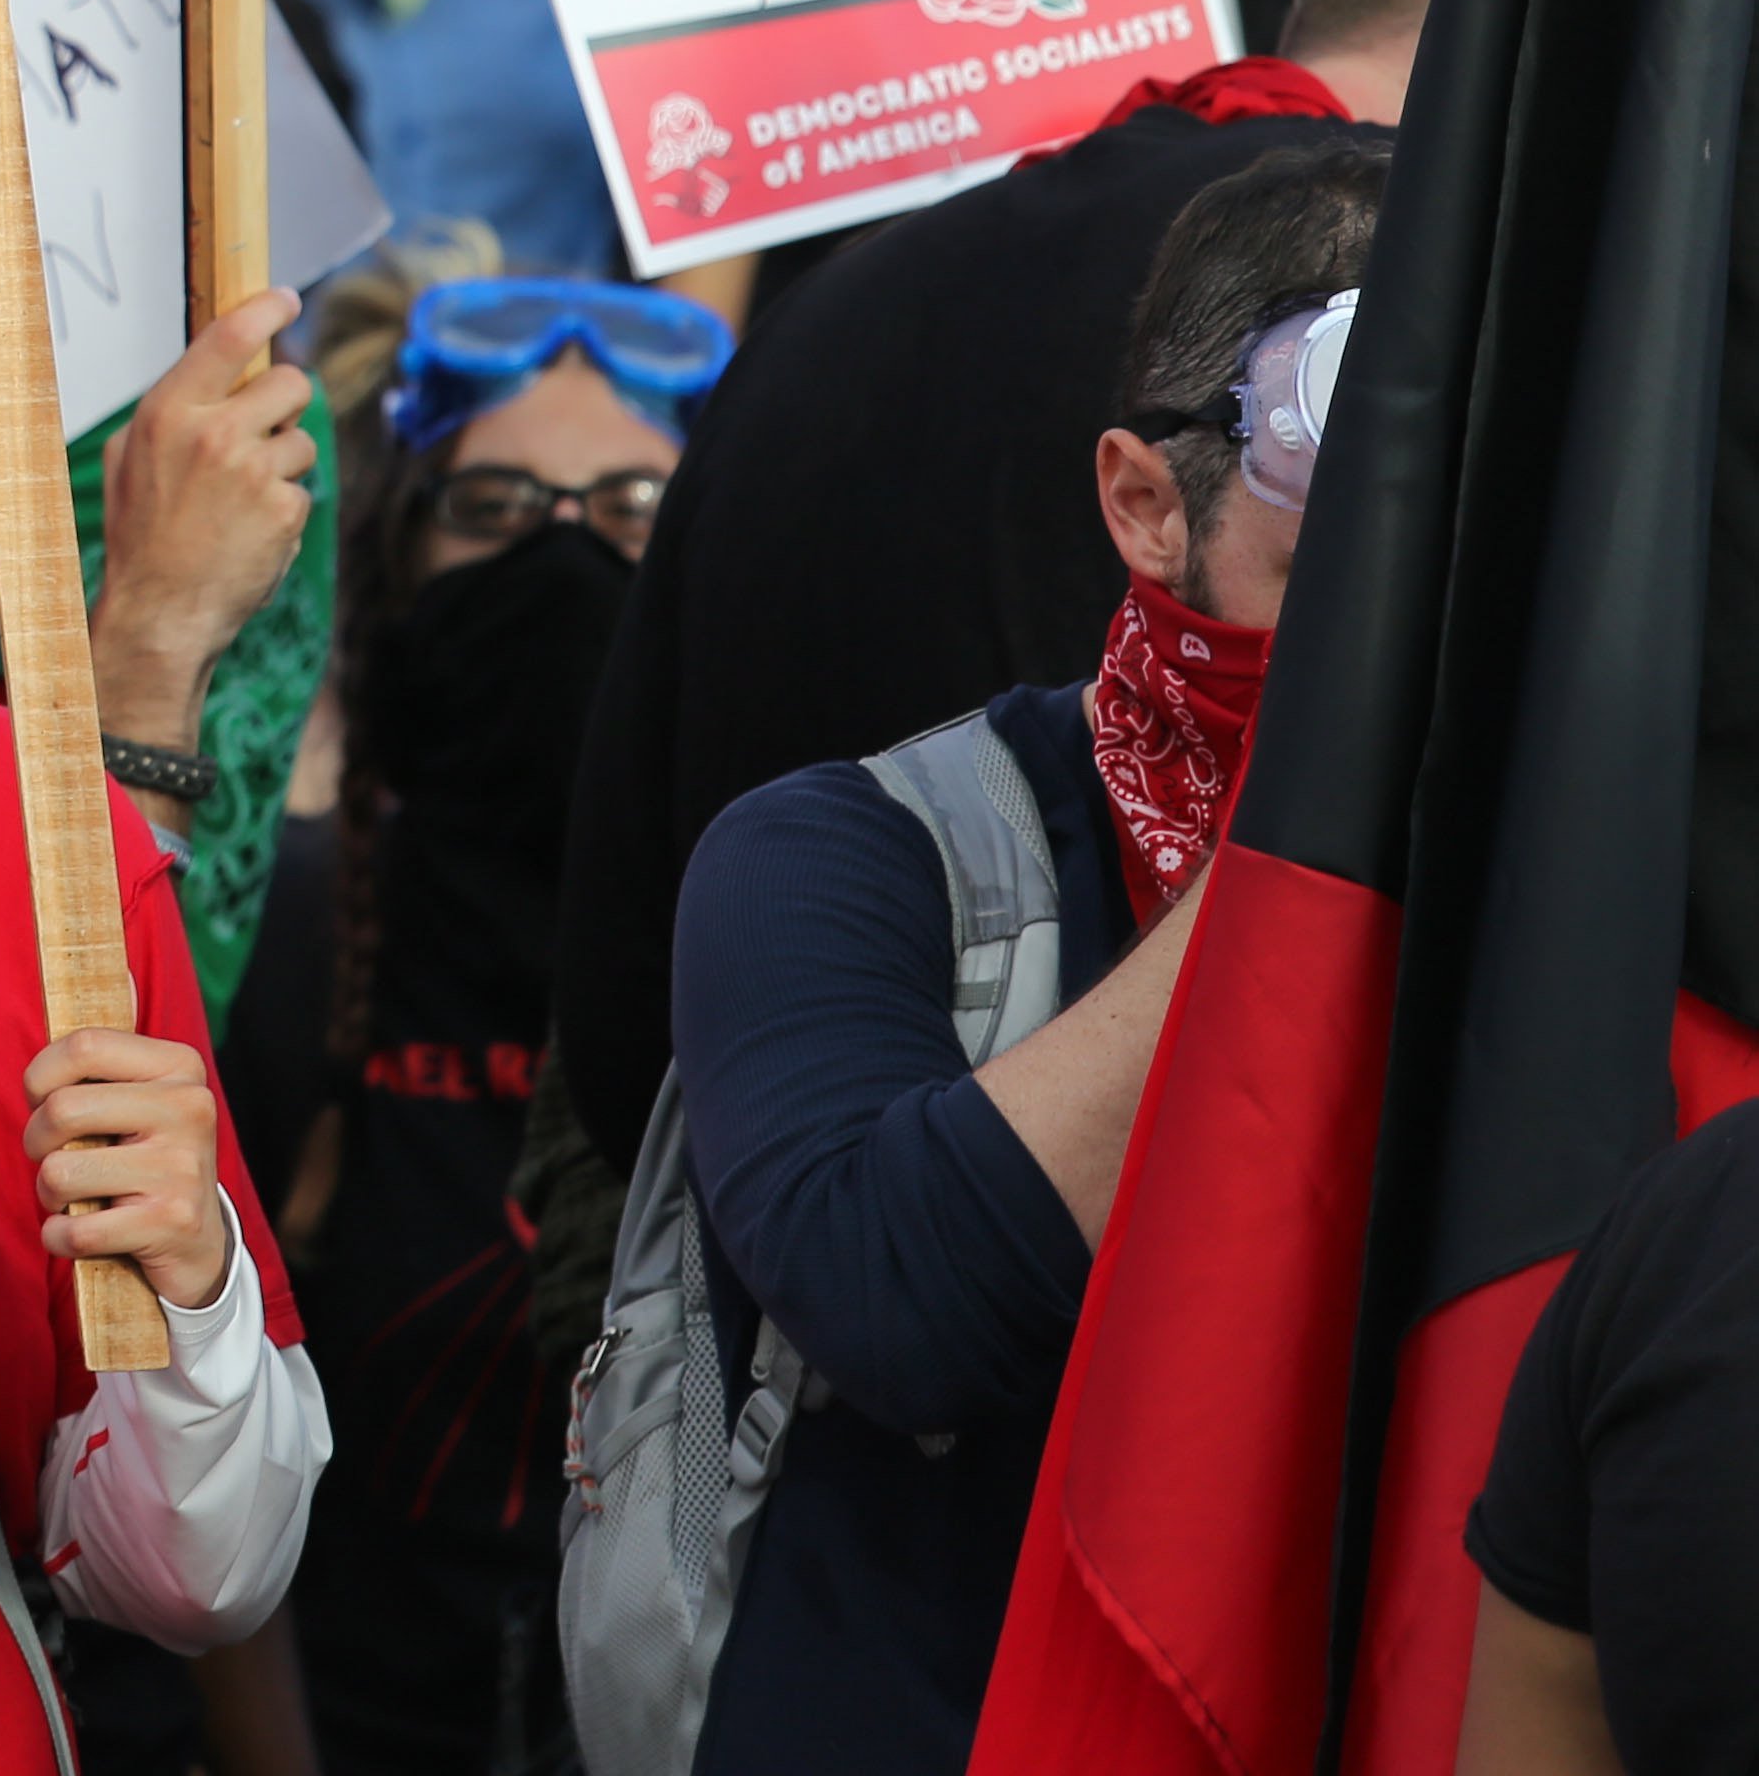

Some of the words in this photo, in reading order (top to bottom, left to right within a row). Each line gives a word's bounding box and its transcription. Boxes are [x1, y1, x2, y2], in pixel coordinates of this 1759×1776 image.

[747, 57, 989, 147] DEMOCRATIC
[993, 4, 1194, 85] SOCIALISTS
[762, 142, 805, 189] of
[814, 106, 982, 176] AMERICA
